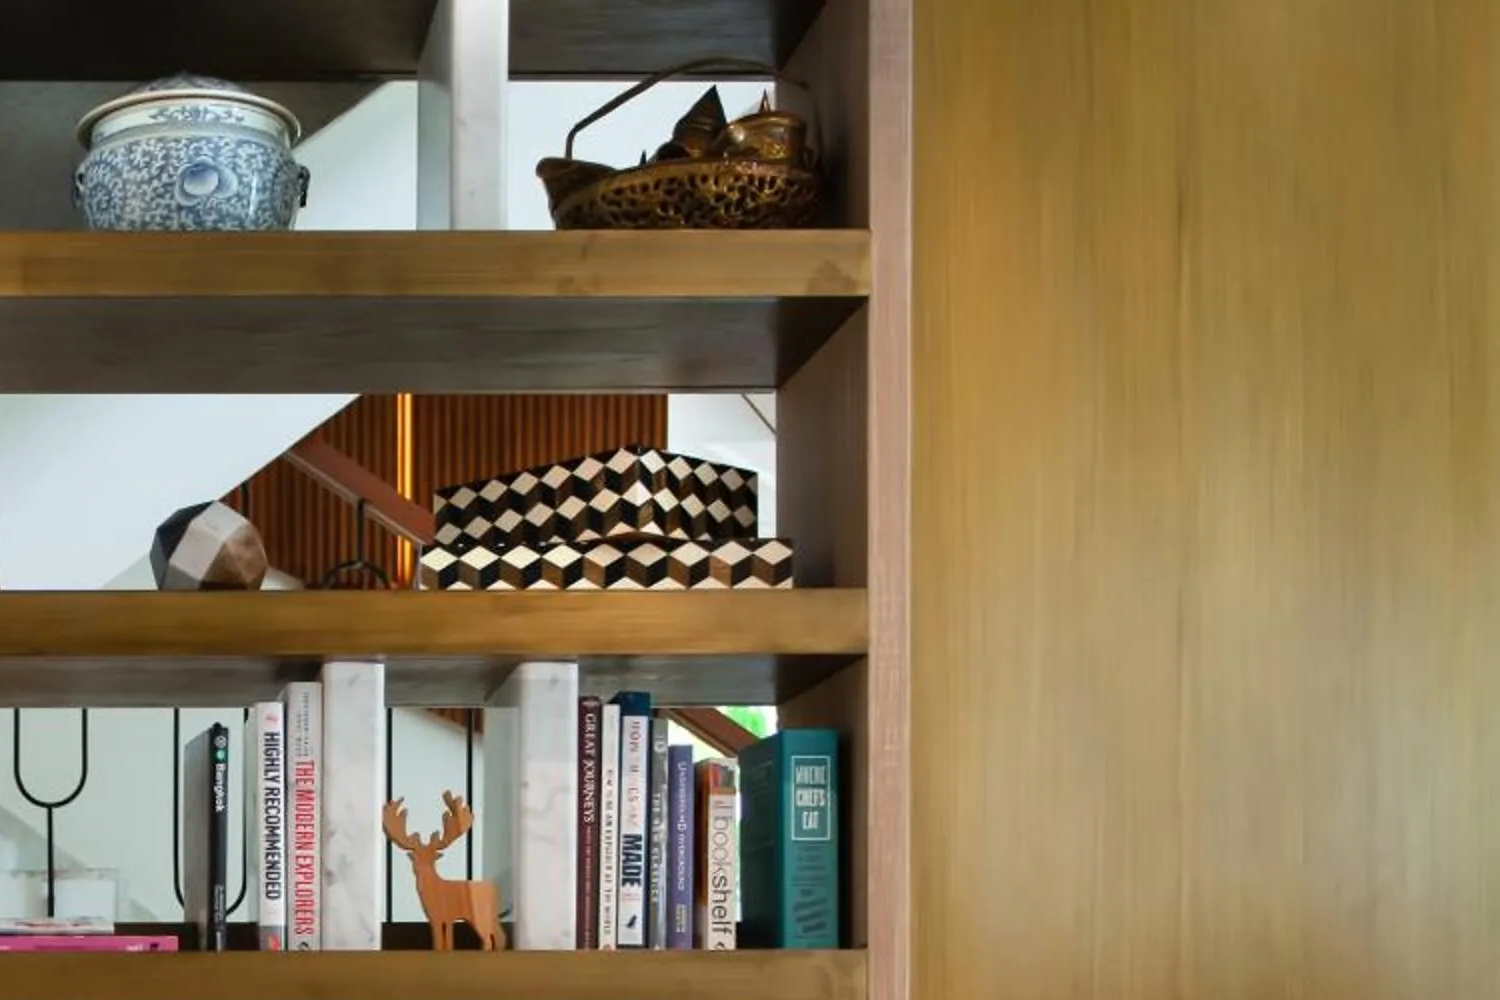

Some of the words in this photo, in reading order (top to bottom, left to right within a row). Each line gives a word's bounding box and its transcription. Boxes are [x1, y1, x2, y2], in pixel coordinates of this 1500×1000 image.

[264, 732, 281, 782] HIGHLY
[584, 713, 596, 757] GREAT
[214, 763, 227, 813] Bangkok
[297, 760, 315, 785] THE
[583, 759, 595, 823] JOURNEYS
[264, 786, 281, 900] RECOMMENDED
[296, 789, 315, 850] MODERN
[622, 834, 642, 887] MADE
[710, 816, 732, 935] bookshelf
[296, 855, 315, 935] EXPLORERS
